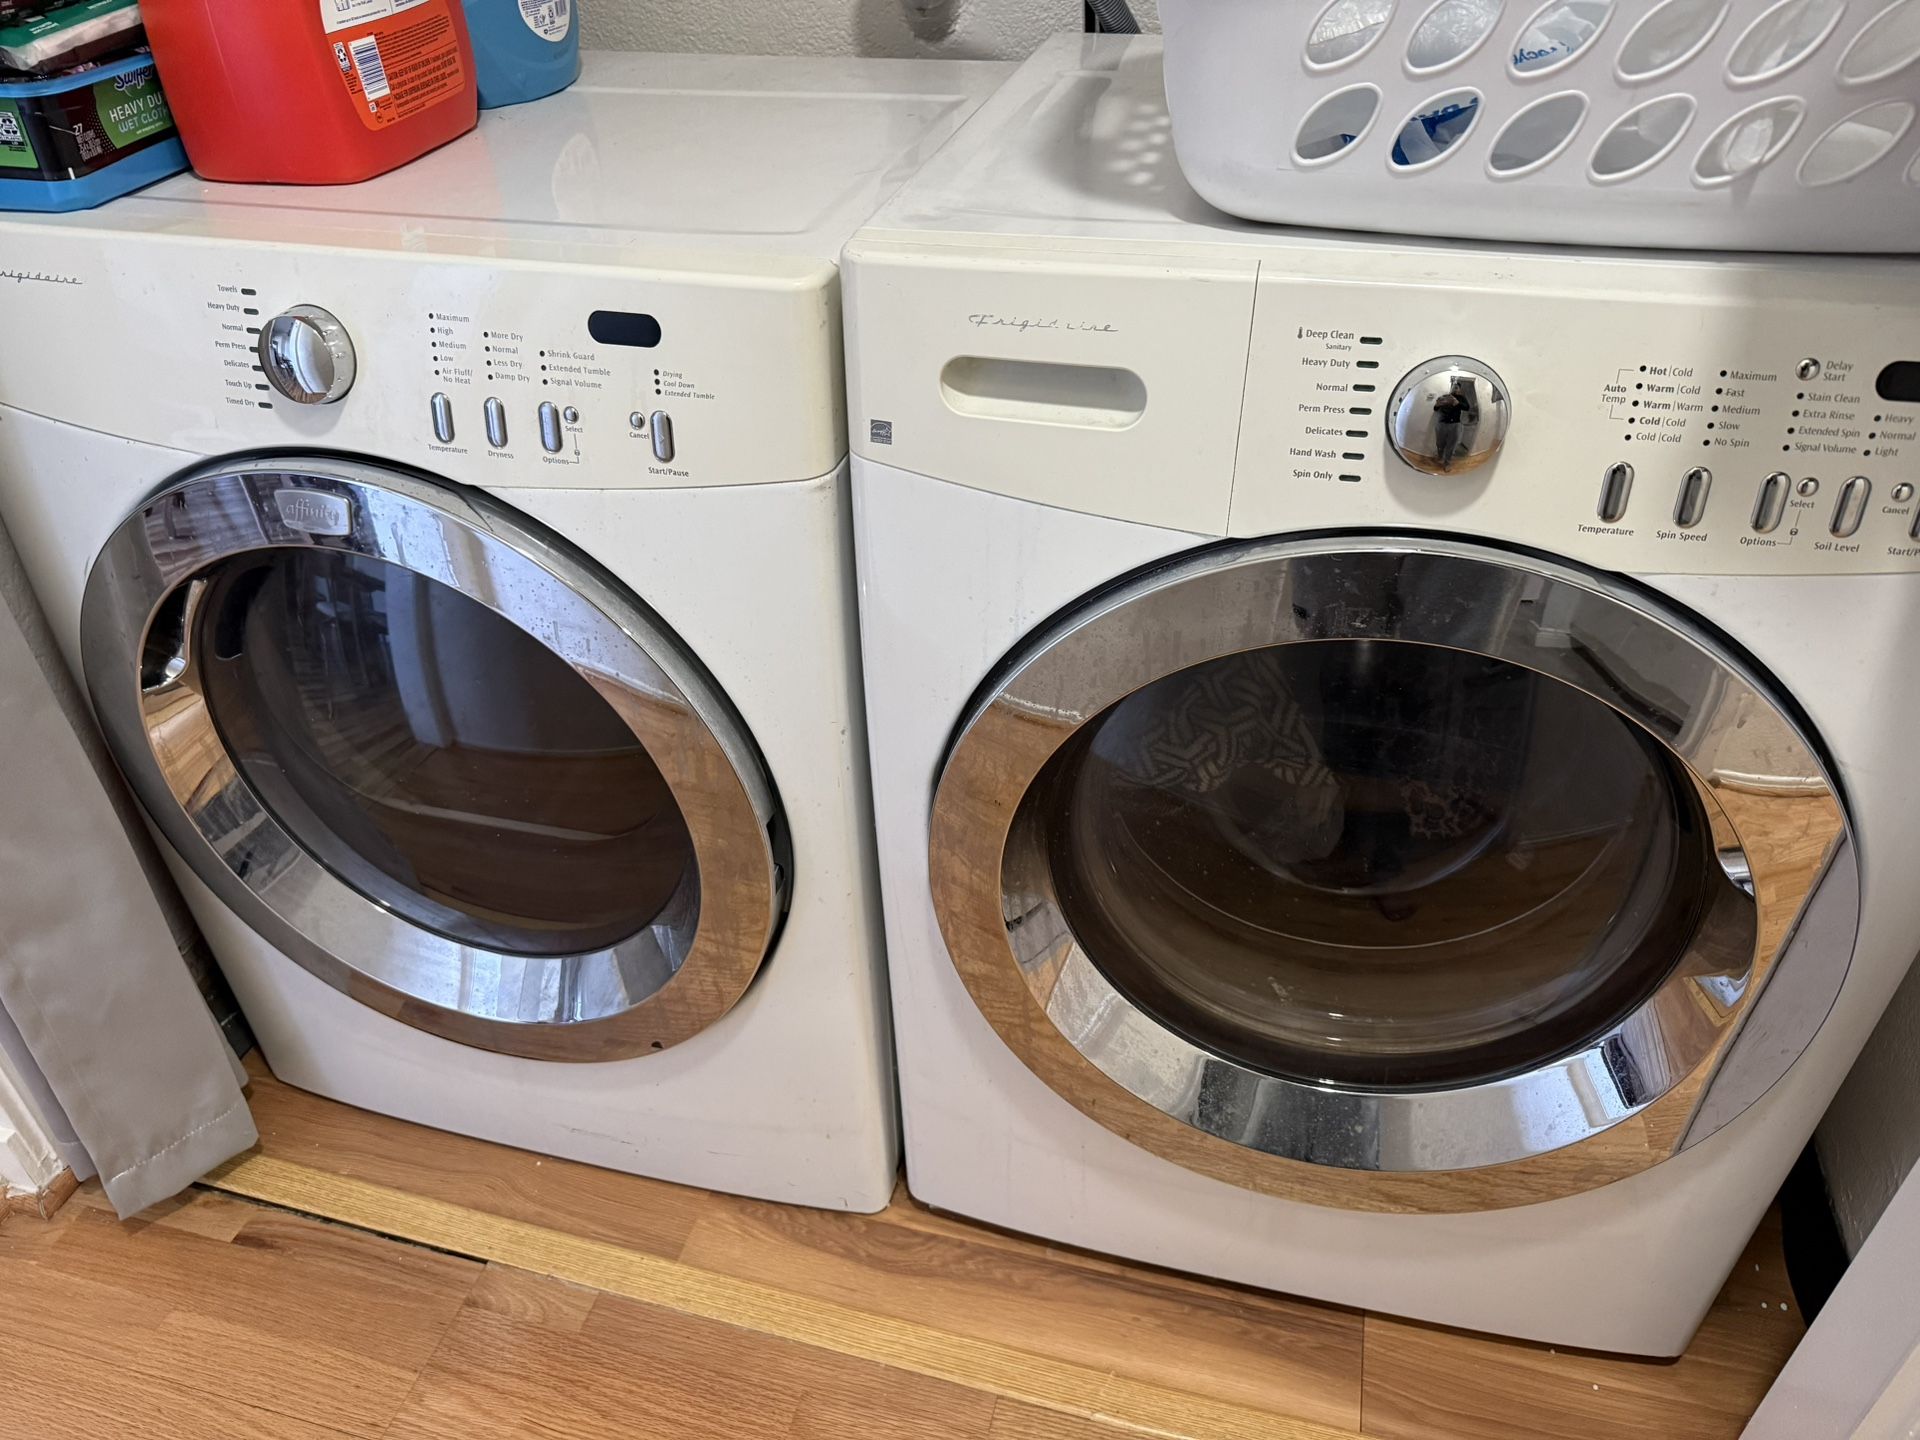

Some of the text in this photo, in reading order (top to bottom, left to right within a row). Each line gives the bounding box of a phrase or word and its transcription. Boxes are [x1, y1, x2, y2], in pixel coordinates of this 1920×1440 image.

[109, 91, 163, 123] HEAVY DU
[73, 123, 82, 135] 27
[118, 116, 139, 133] WET
[0, 269, 83, 283] rigidaire
[217, 284, 238, 293] Towels
[207, 302, 240, 312] Heavy Duty
[436, 313, 470, 322] Maximum
[222, 323, 244, 332] Normal
[437, 327, 454, 336] High
[491, 331, 524, 342] More Dry
[1306, 329, 1355, 340] Deep Clean
[215, 341, 246, 350] Perm Press
[439, 341, 467, 350] Medium
[492, 346, 519, 354] Normal
[1325, 343, 1352, 352] Sanitary
[547, 350, 595, 361] Shrink Guard
[224, 360, 250, 368] Delicates
[510, 360, 523, 369] Dry
[1302, 357, 1350, 369] Heavy Duty
[1826, 360, 1854, 372] Delay
[442, 368, 453, 376] Air
[548, 364, 611, 376] Extended Tumble
[495, 373, 530, 383] Damp Dry
[662, 371, 683, 380] Drying
[1730, 371, 1777, 382] Maximum
[1823, 372, 1846, 382] Start
[225, 379, 252, 389] Touch Up
[455, 377, 471, 385] Heat
[550, 378, 602, 389] Signal Volume
[1316, 383, 1348, 392] Normal
[1604, 384, 1627, 393] Auto
[664, 390, 715, 400] Extended Tumble
[1725, 388, 1745, 398] Fast
[1808, 392, 1861, 403] Stain Clean
[226, 397, 255, 408] Timed Dry
[1601, 394, 1626, 404] Temp
[1298, 404, 1345, 414] Perm Press
[1722, 405, 1761, 416] Medium
[1803, 409, 1855, 421] Extra Rinse
[1885, 414, 1915, 425] Heavy
[565, 425, 583, 434] Select
[1718, 421, 1741, 430] Slow
[629, 431, 650, 440] Cancel
[1305, 427, 1343, 436] Delicates
[1798, 426, 1861, 439] Extended Spin
[1879, 431, 1916, 441] Normal
[1714, 437, 1750, 449] No Spin
[1794, 441, 1857, 454] Signal Volume
[428, 443, 468, 455] Temperature
[1290, 448, 1336, 458] Hand Wash
[1874, 447, 1899, 457] Light
[488, 449, 514, 460] Dryness
[542, 456, 570, 466] Options
[648, 466, 689, 477] Start/Pause
[1293, 469, 1333, 480] Spin Only
[1789, 500, 1815, 509] Select
[286, 498, 340, 527] affinity
[1882, 506, 1910, 515] Cancel
[1577, 523, 1634, 536] Temperature
[1655, 530, 1707, 542] Spin Speed
[1740, 536, 1777, 547] Options
[1814, 541, 1860, 553] Soil Level
